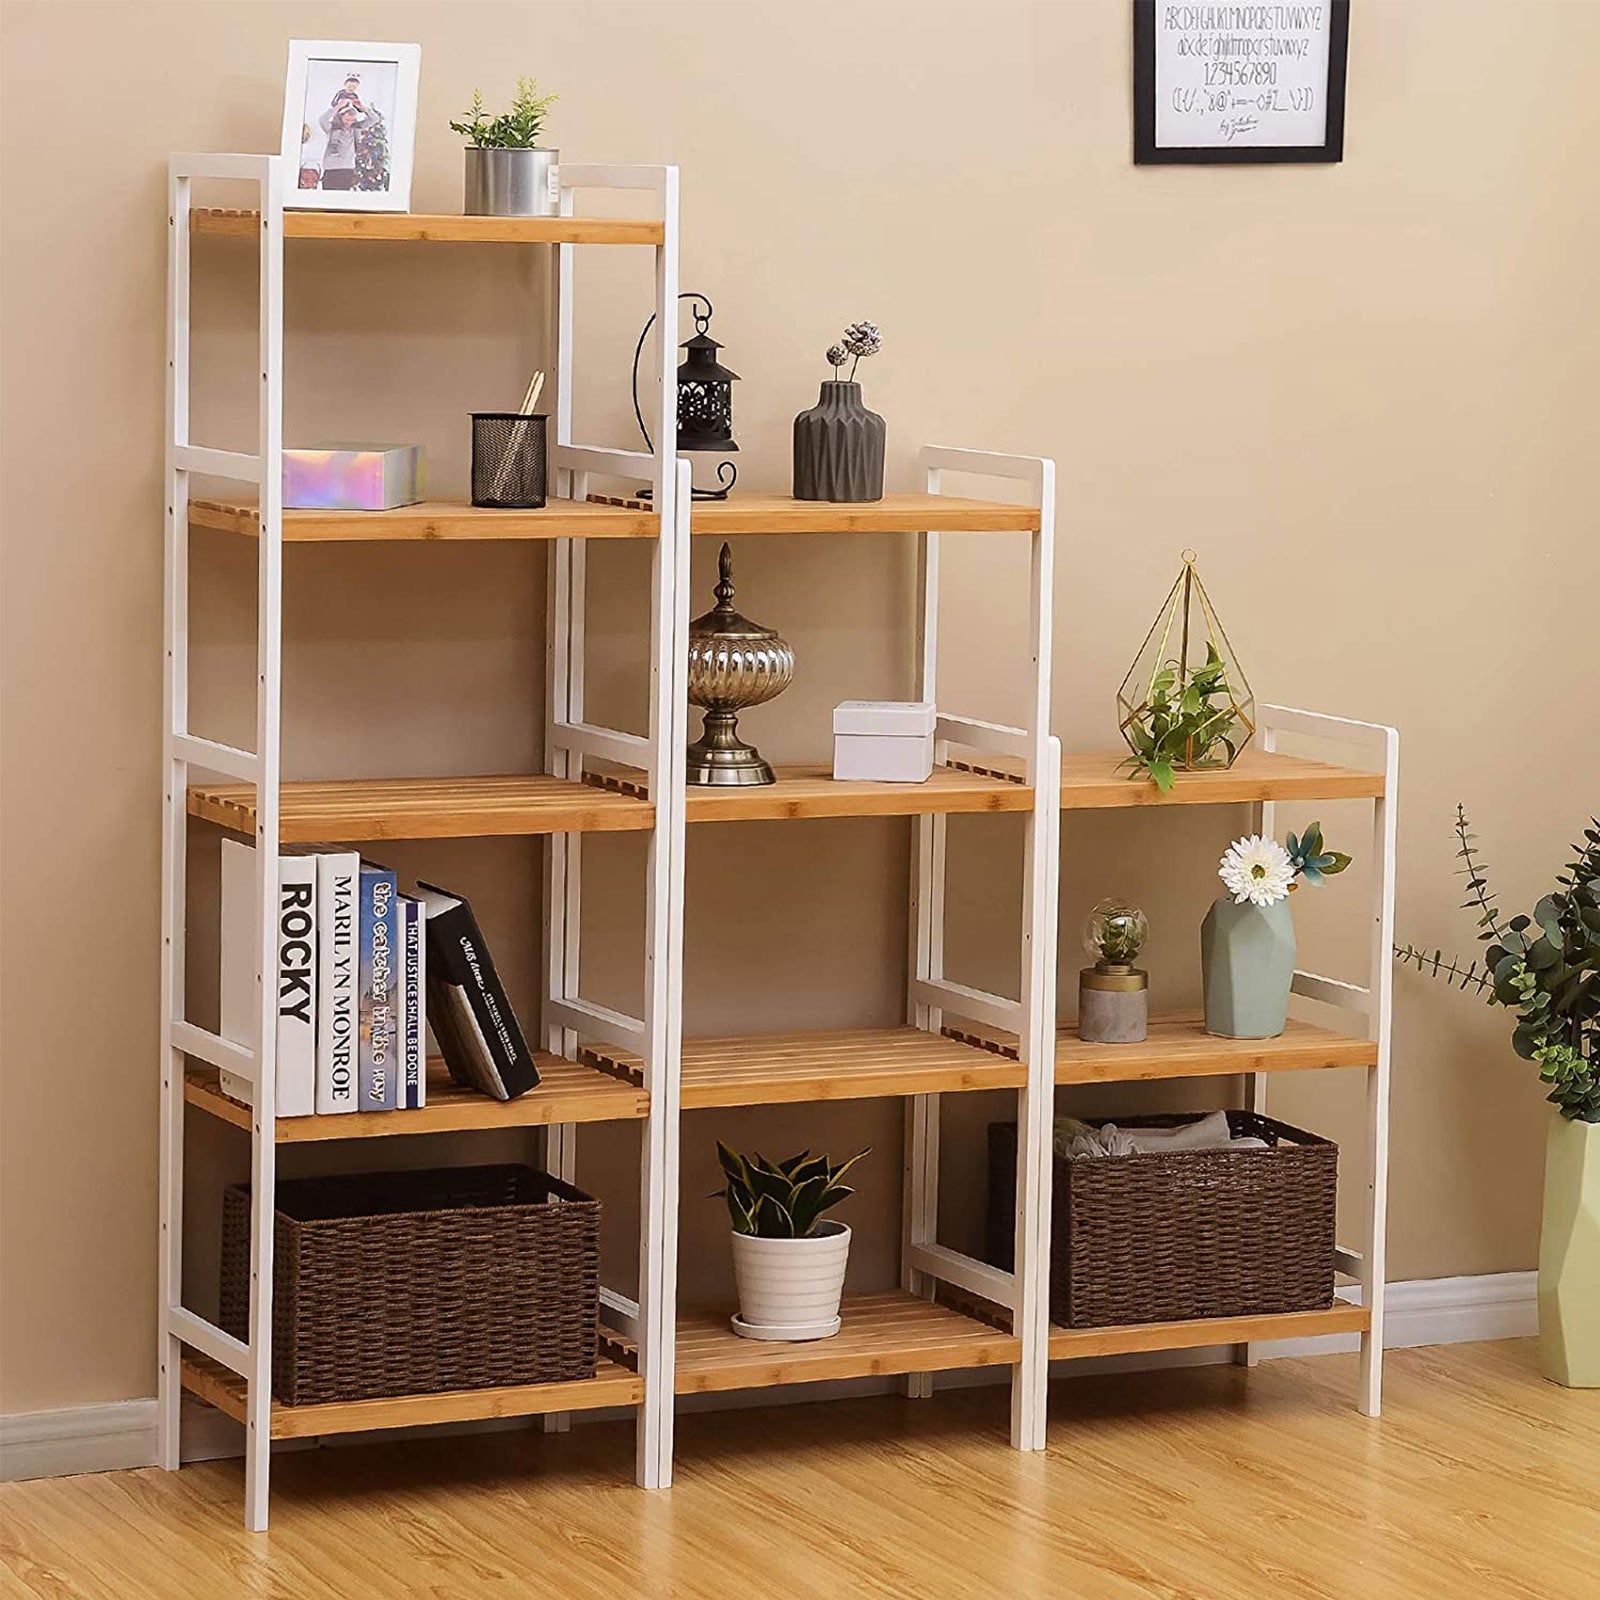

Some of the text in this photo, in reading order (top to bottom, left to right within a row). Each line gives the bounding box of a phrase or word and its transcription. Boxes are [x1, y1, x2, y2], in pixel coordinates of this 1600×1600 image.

[1204, 62, 1277, 86] 1234567890
[373, 882, 392, 917] the
[279, 883, 312, 1024] ROCKY
[332, 876, 352, 1100] MARILYN MONROE
[372, 922, 390, 1001] catcher
[371, 1006, 390, 1027] in
[406, 921, 418, 1086] THAT JUSTICE SHALL BE DONE
